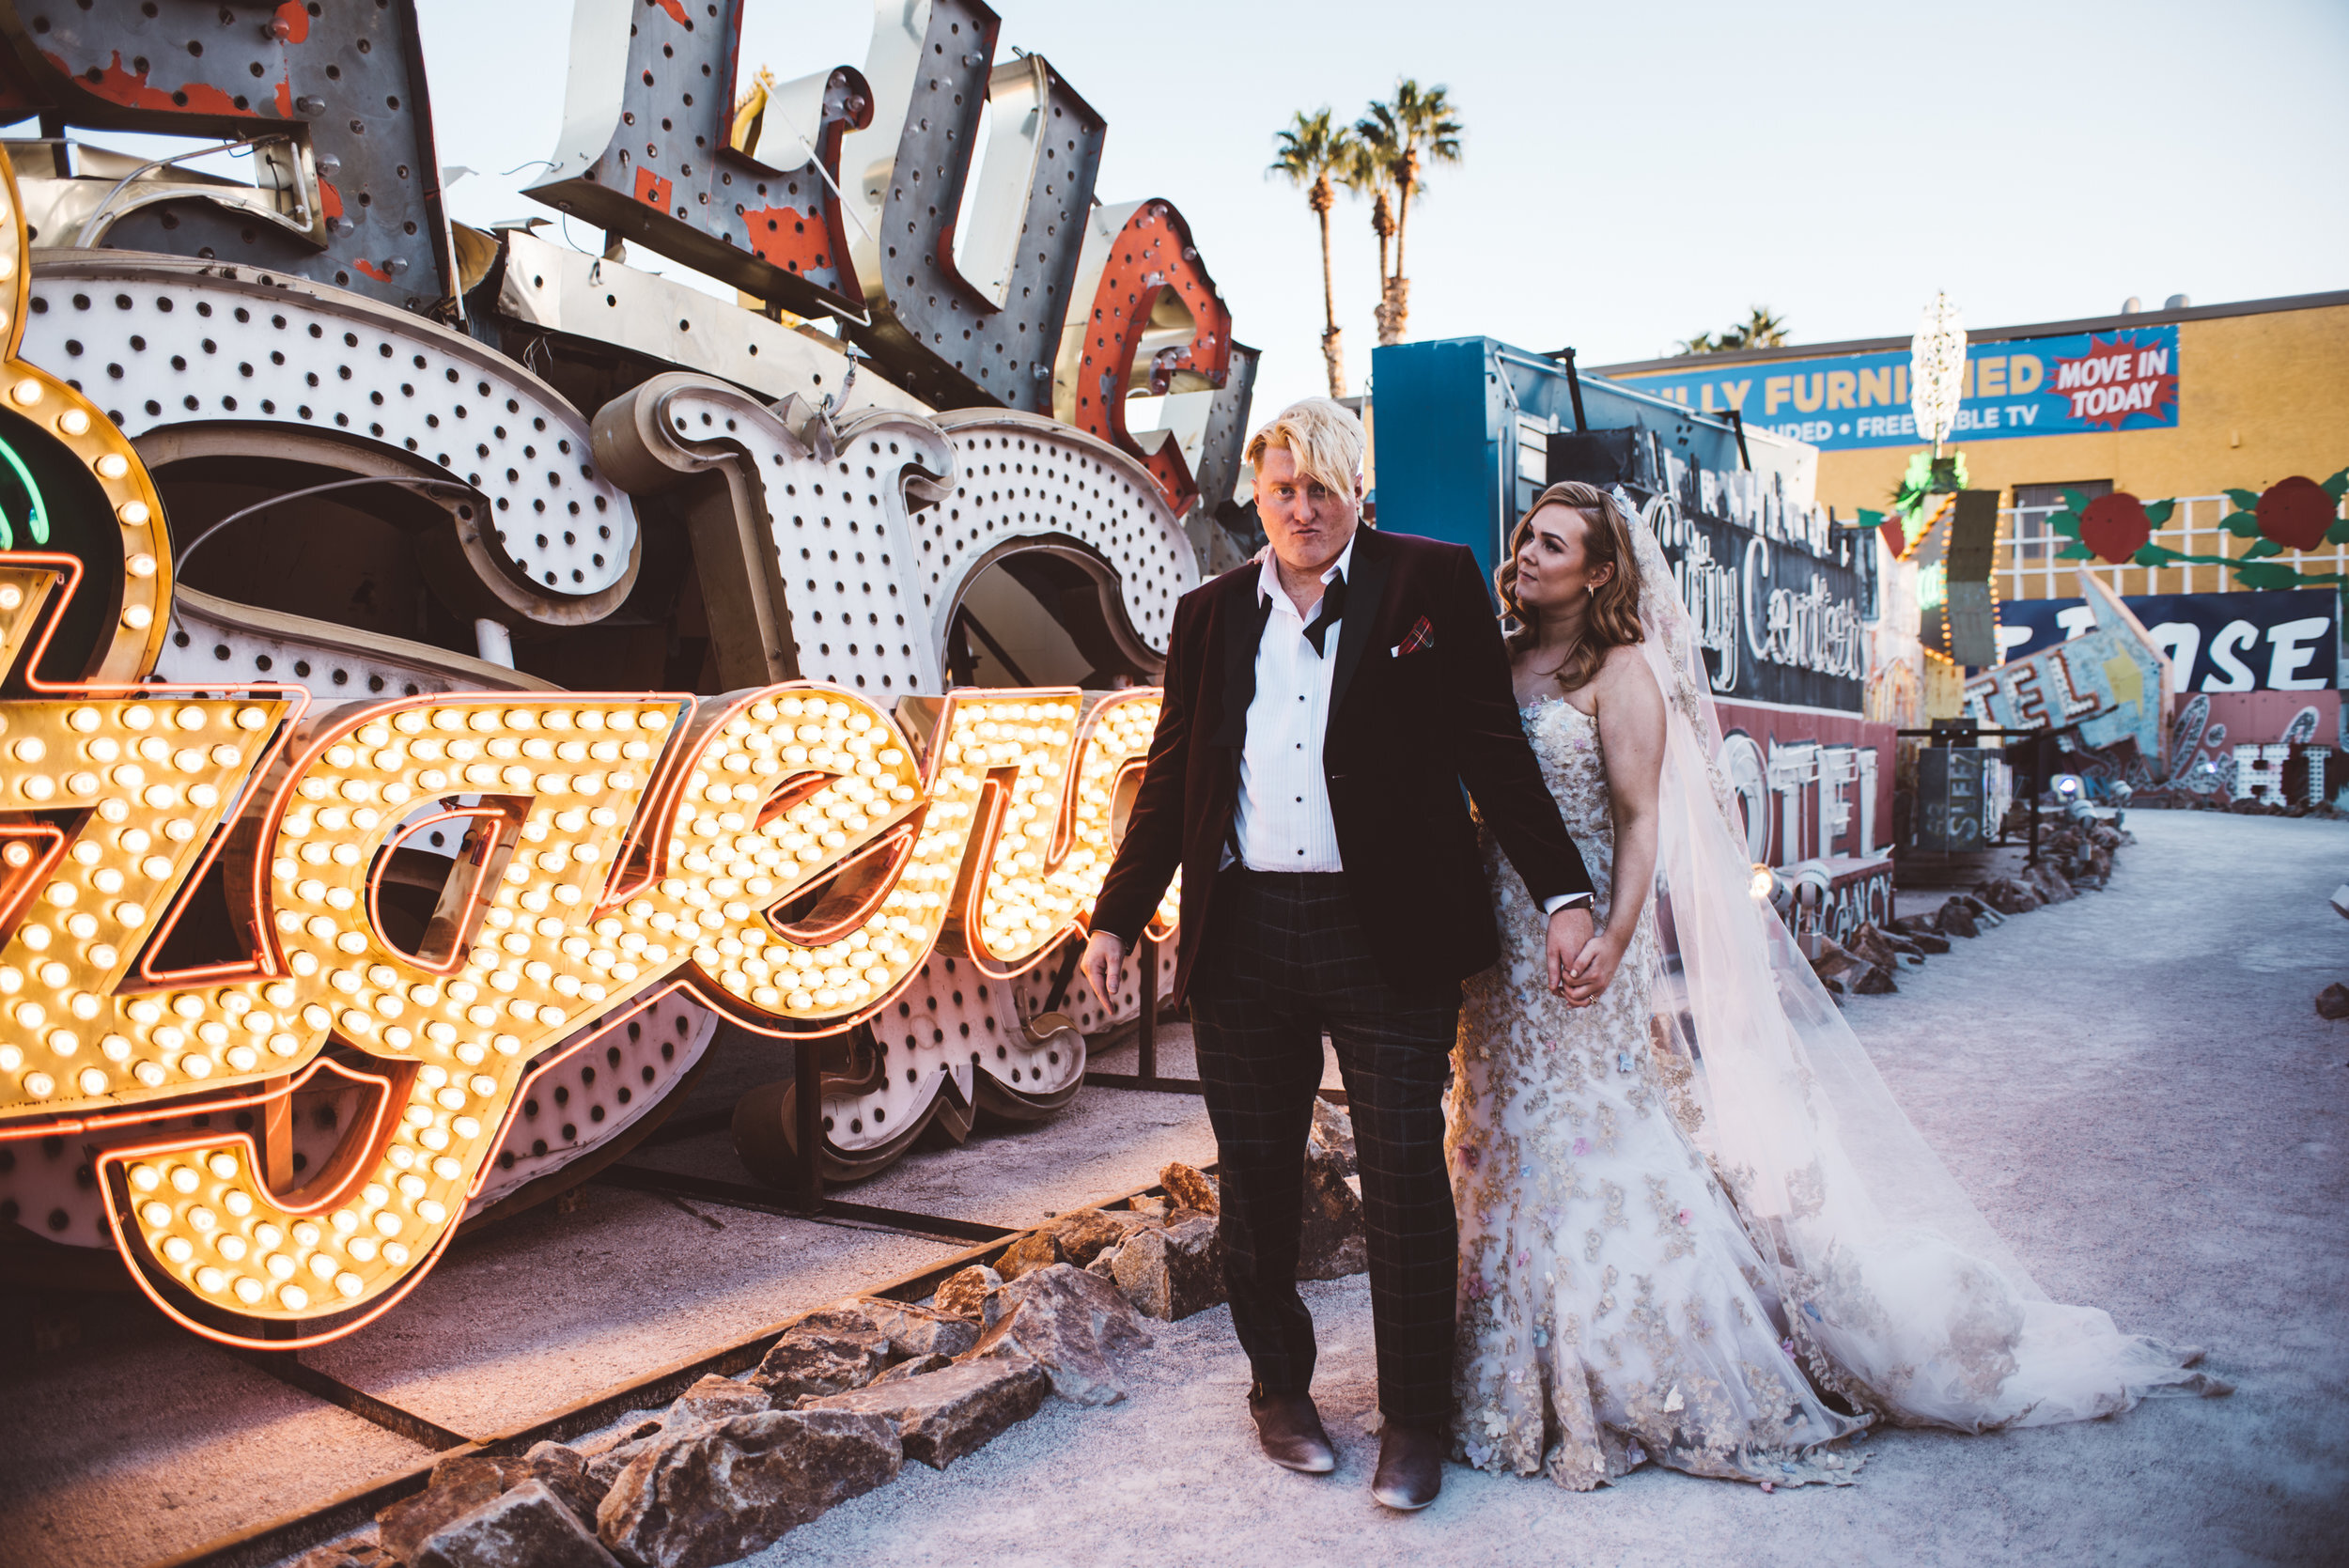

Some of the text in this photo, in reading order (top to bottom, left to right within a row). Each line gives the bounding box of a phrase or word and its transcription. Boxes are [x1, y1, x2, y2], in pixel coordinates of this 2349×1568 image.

[1765, 354, 2045, 415] FURNIED
[2058, 348, 2169, 391] MOVE IN
[1760, 420, 1833, 442] UDED
[1857, 413, 1915, 438] FREE
[2004, 404, 2039, 427] TV
[2072, 380, 2158, 418] TODAY
[1743, 536, 1868, 680] Center
[1719, 728, 1895, 866] OTEL
